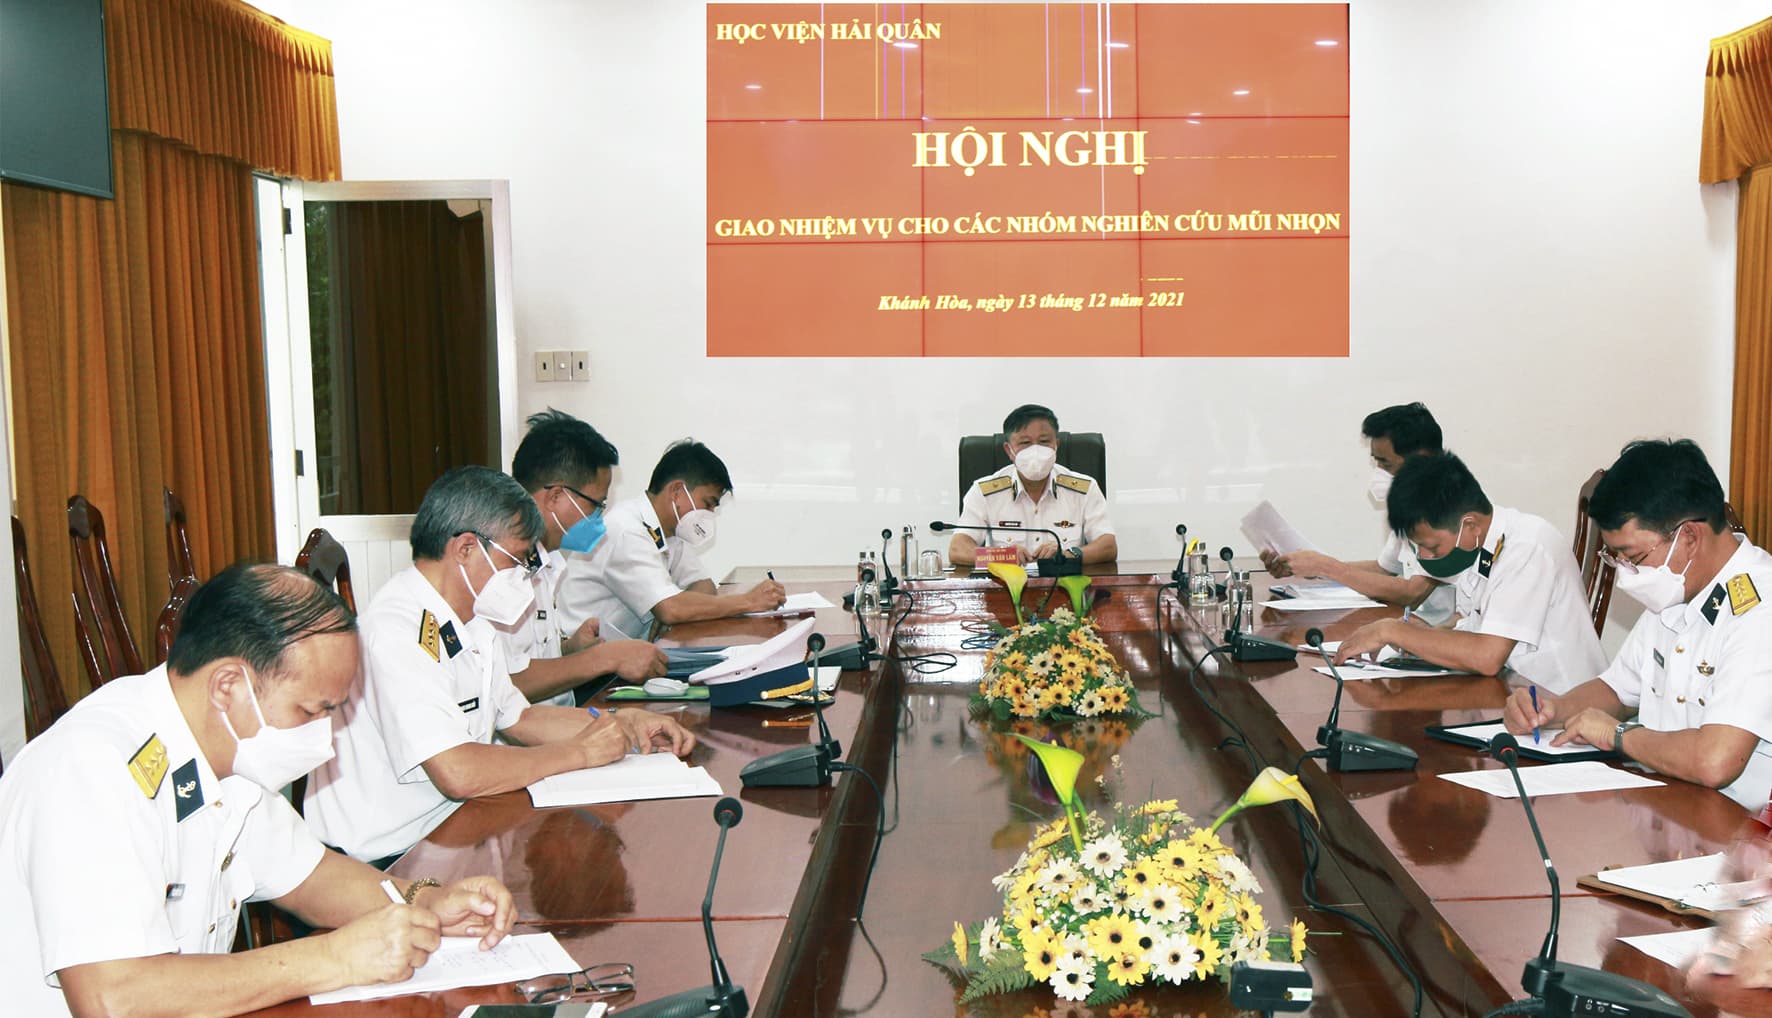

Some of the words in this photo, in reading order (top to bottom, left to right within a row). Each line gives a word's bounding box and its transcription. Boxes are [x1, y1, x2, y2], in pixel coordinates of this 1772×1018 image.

[716, 23, 766, 44] HỌC
[770, 21, 825, 44] VIỆN
[830, 19, 872, 40] HẢI
[876, 18, 942, 43] QUÂN
[911, 125, 1007, 177] HỘI
[1018, 130, 1149, 176] NGHỊ
[715, 218, 775, 237] GIAO
[778, 215, 857, 240] NHIỆM
[860, 217, 893, 240] VỤ
[897, 216, 950, 235] CHO
[953, 211, 1002, 234] CÁC
[1006, 211, 1077, 233] NHÓM
[1080, 210, 1170, 233] NGHIÊN
[1174, 210, 1223, 232] CỨU
[1227, 209, 1272, 231] MŨI
[1276, 213, 1341, 234] NHỌN
[878, 295, 930, 311] Khánh
[934, 294, 974, 312] Hòa,
[976, 294, 1015, 313] ngày
[1017, 294, 1036, 309] 13
[1039, 292, 1085, 312] tháng
[1087, 293, 1107, 308] 12
[1109, 293, 1144, 308] năm
[1147, 291, 1185, 307] 2021
